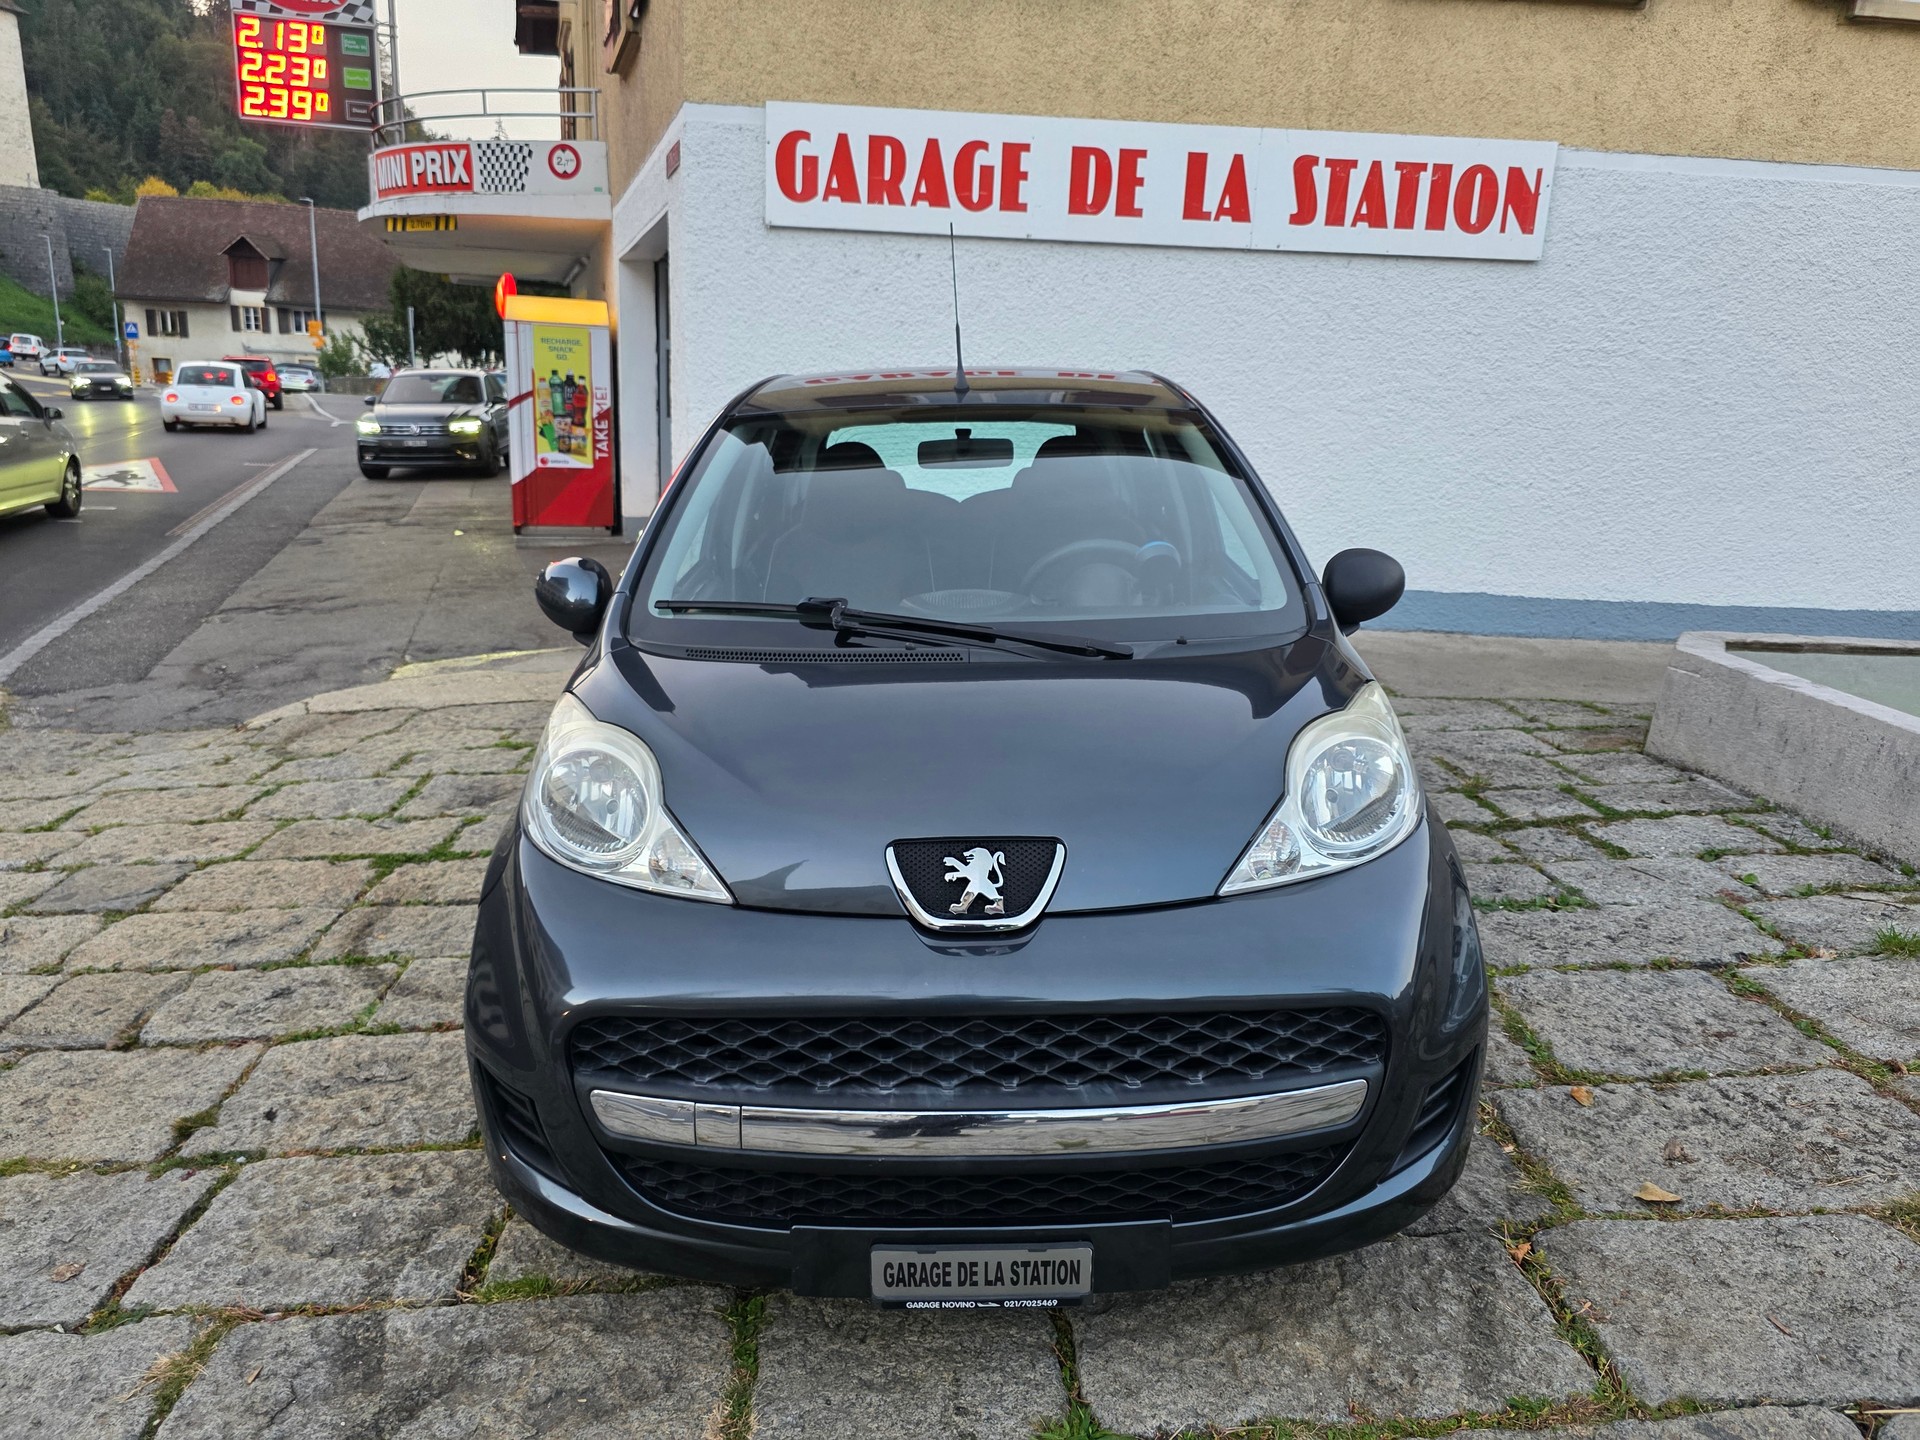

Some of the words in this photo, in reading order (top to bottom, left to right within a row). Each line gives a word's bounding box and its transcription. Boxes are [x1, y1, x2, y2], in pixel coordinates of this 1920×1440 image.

[377, 153, 408, 190] MINI
[410, 149, 471, 186] PRIX
[775, 128, 1031, 214] GARAGE
[1068, 145, 1148, 219] DE
[1181, 151, 1252, 224] LA
[1289, 153, 1544, 236] STATION
[594, 419, 609, 460] TAKE
[883, 1261, 952, 1288] GARAGE
[957, 1261, 979, 1287] DE
[984, 1261, 1005, 1287] LA
[1010, 1259, 1081, 1287] STATION
[906, 1301, 940, 1309] GARAGE
[1004, 1299, 1058, 1308] 021/7025469
